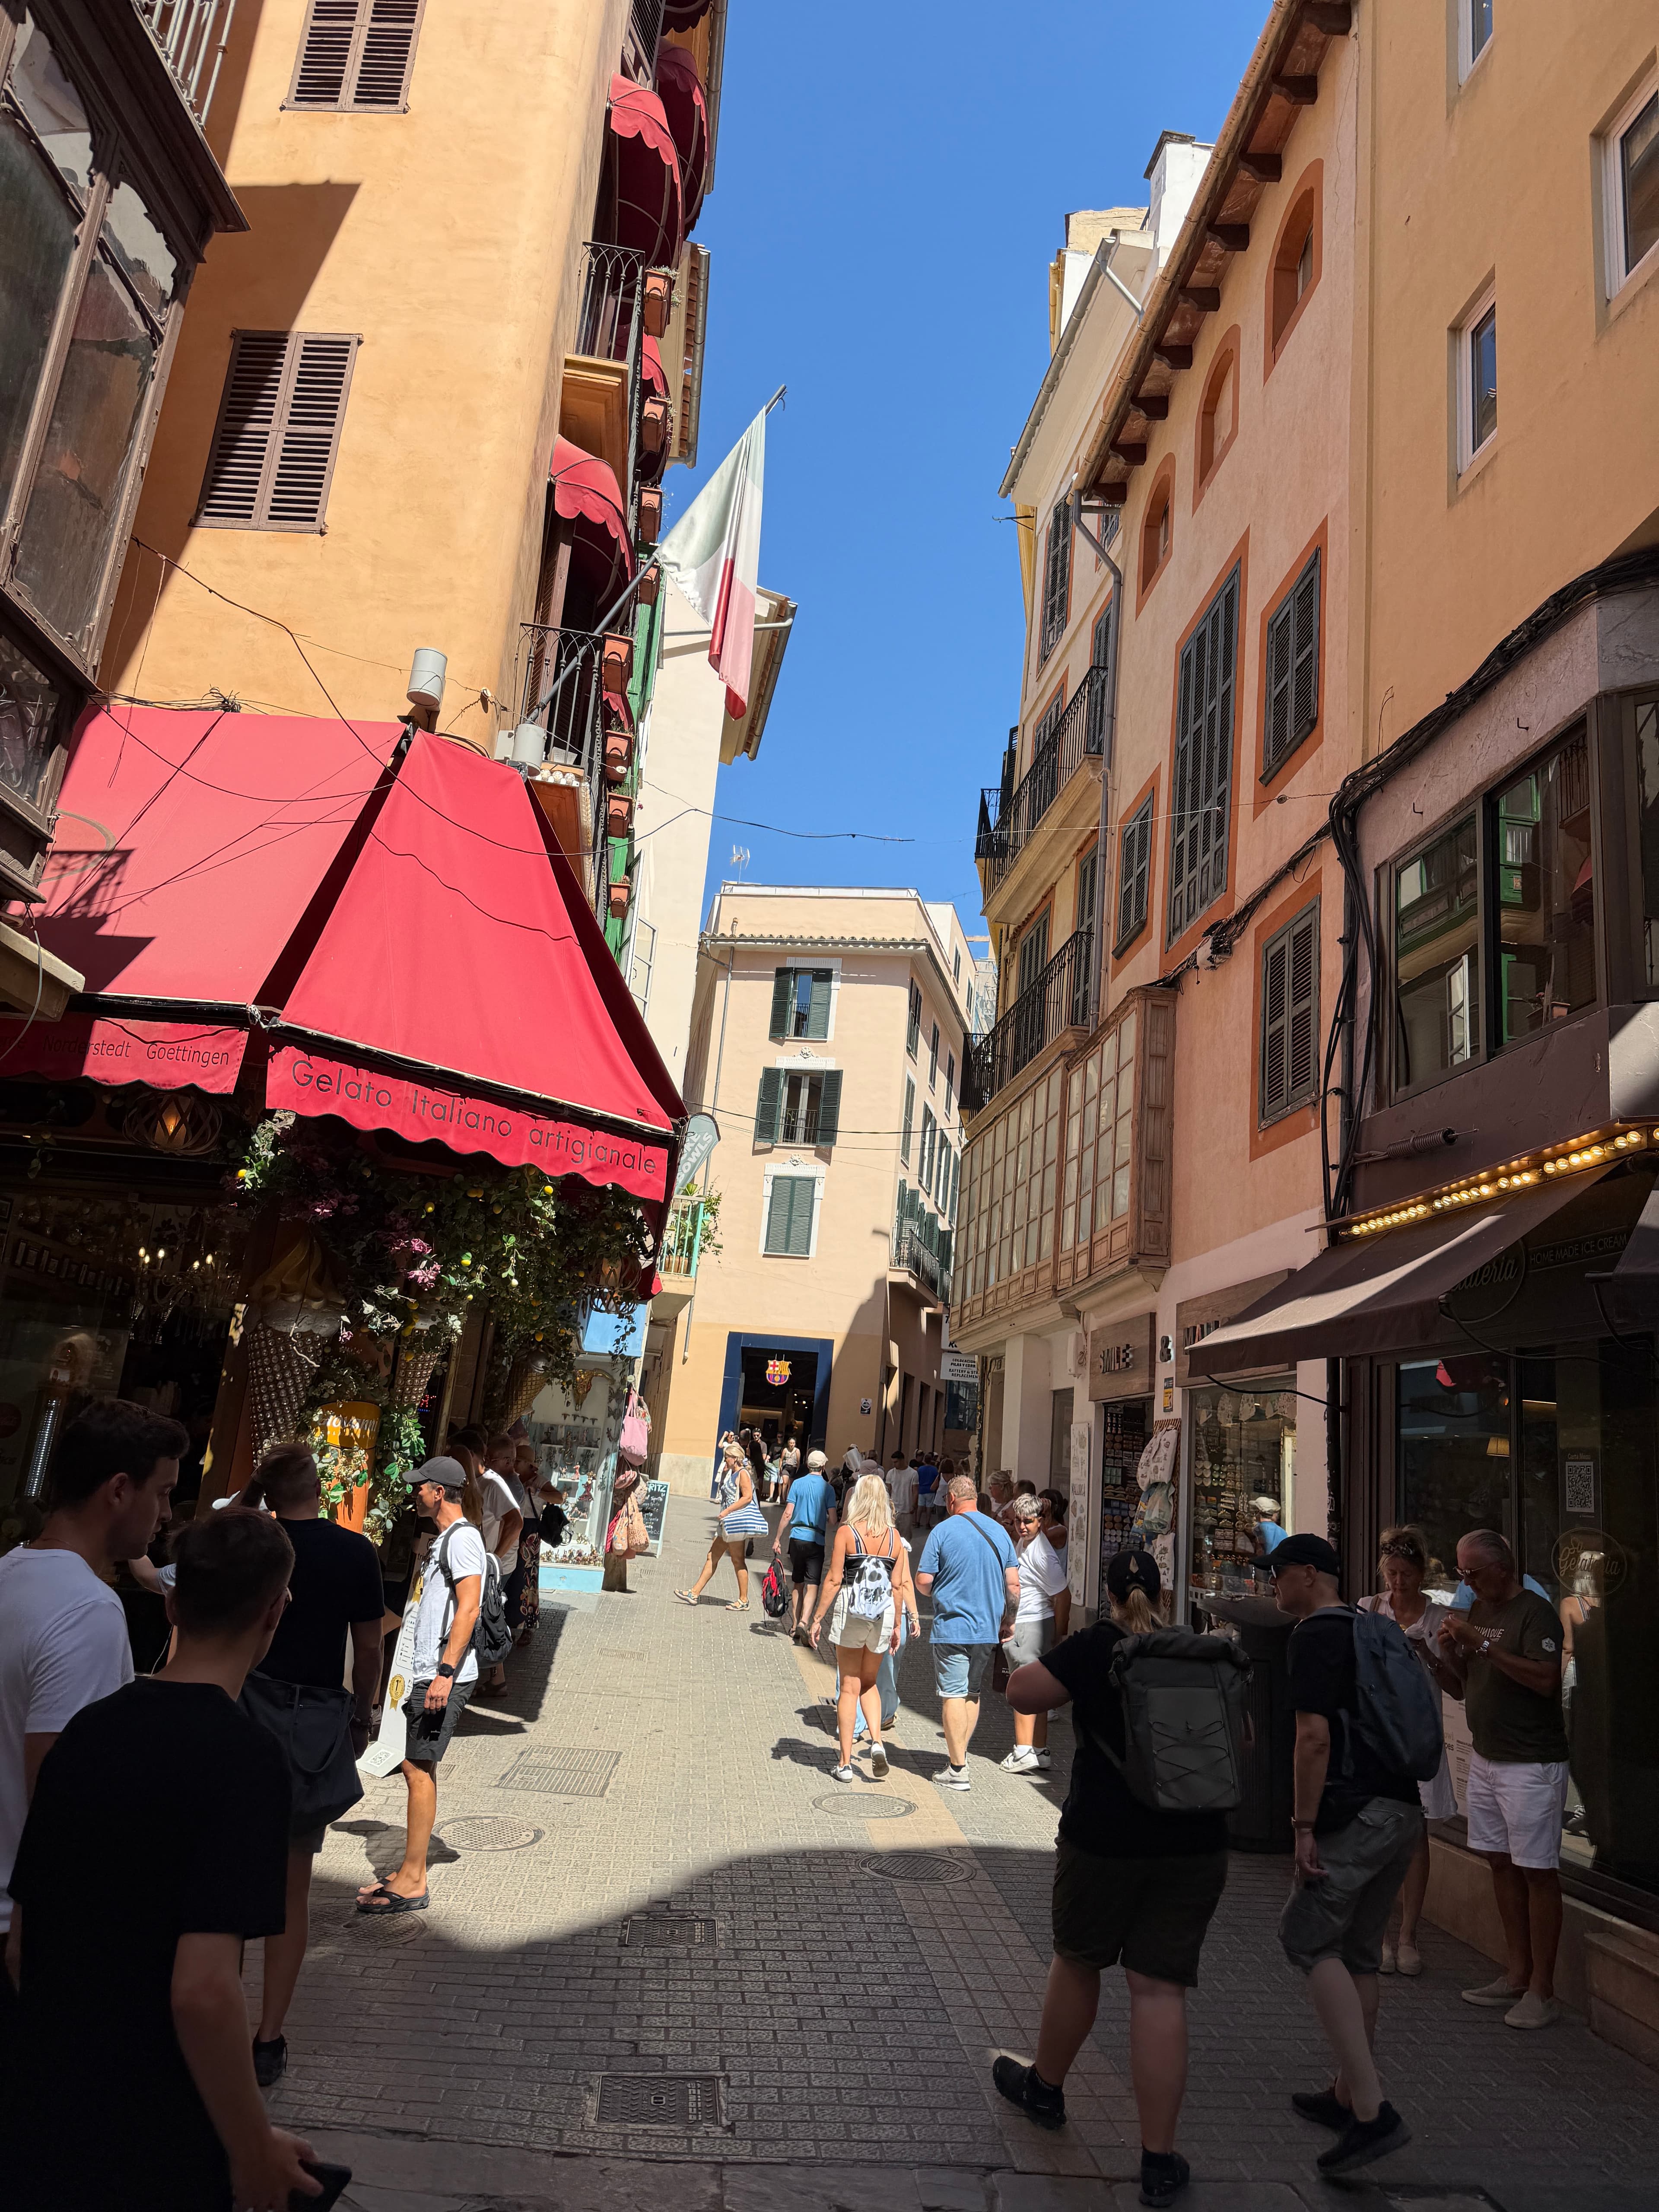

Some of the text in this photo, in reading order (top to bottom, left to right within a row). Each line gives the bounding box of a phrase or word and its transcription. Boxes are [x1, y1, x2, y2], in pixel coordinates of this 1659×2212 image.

[43, 1035, 131, 1057] Norderstedt
[147, 1042, 229, 1068] Goettingen
[292, 1060, 656, 1175] Gelato Italiano artigianale
[677, 1132, 713, 1183] BOWLS
[1531, 1233, 1627, 1266] HOME MADE ICE CREAM
[1099, 1344, 1130, 1373] SMILE
[1159, 1335, 1172, 1363] &
[648, 1483, 667, 1493] RITZ
